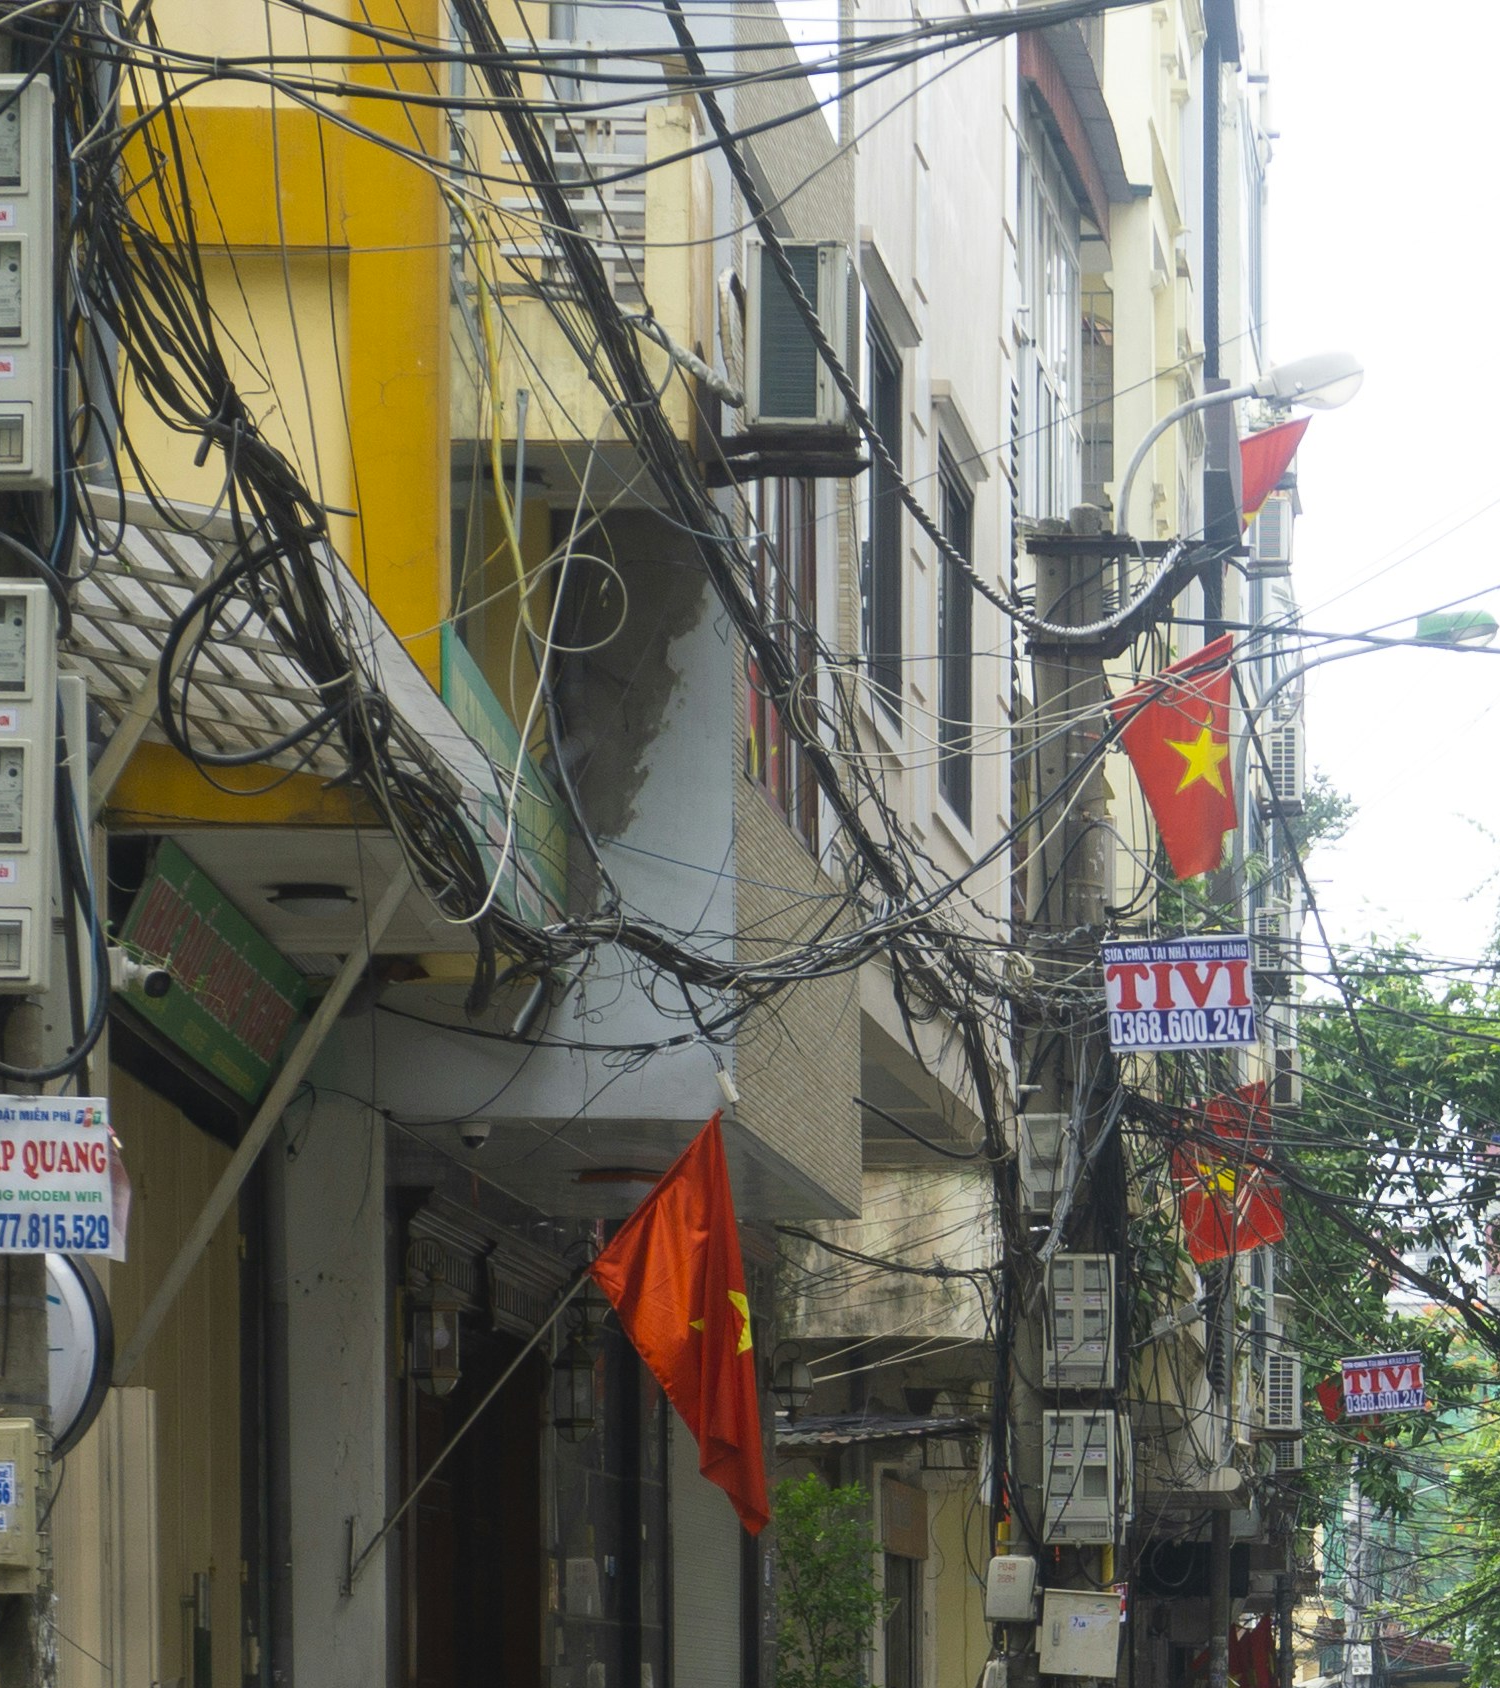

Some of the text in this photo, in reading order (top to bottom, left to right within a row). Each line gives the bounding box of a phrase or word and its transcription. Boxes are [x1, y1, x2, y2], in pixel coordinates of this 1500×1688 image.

[1106, 960, 1251, 1010] TIVI
[1110, 1009, 1252, 1044] 0368.600.247
[22, 1140, 107, 1180] QUANG
[18, 1190, 71, 1202] MODEM
[75, 1191, 103, 1203] WIFI
[1344, 1364, 1423, 1394] TIVI
